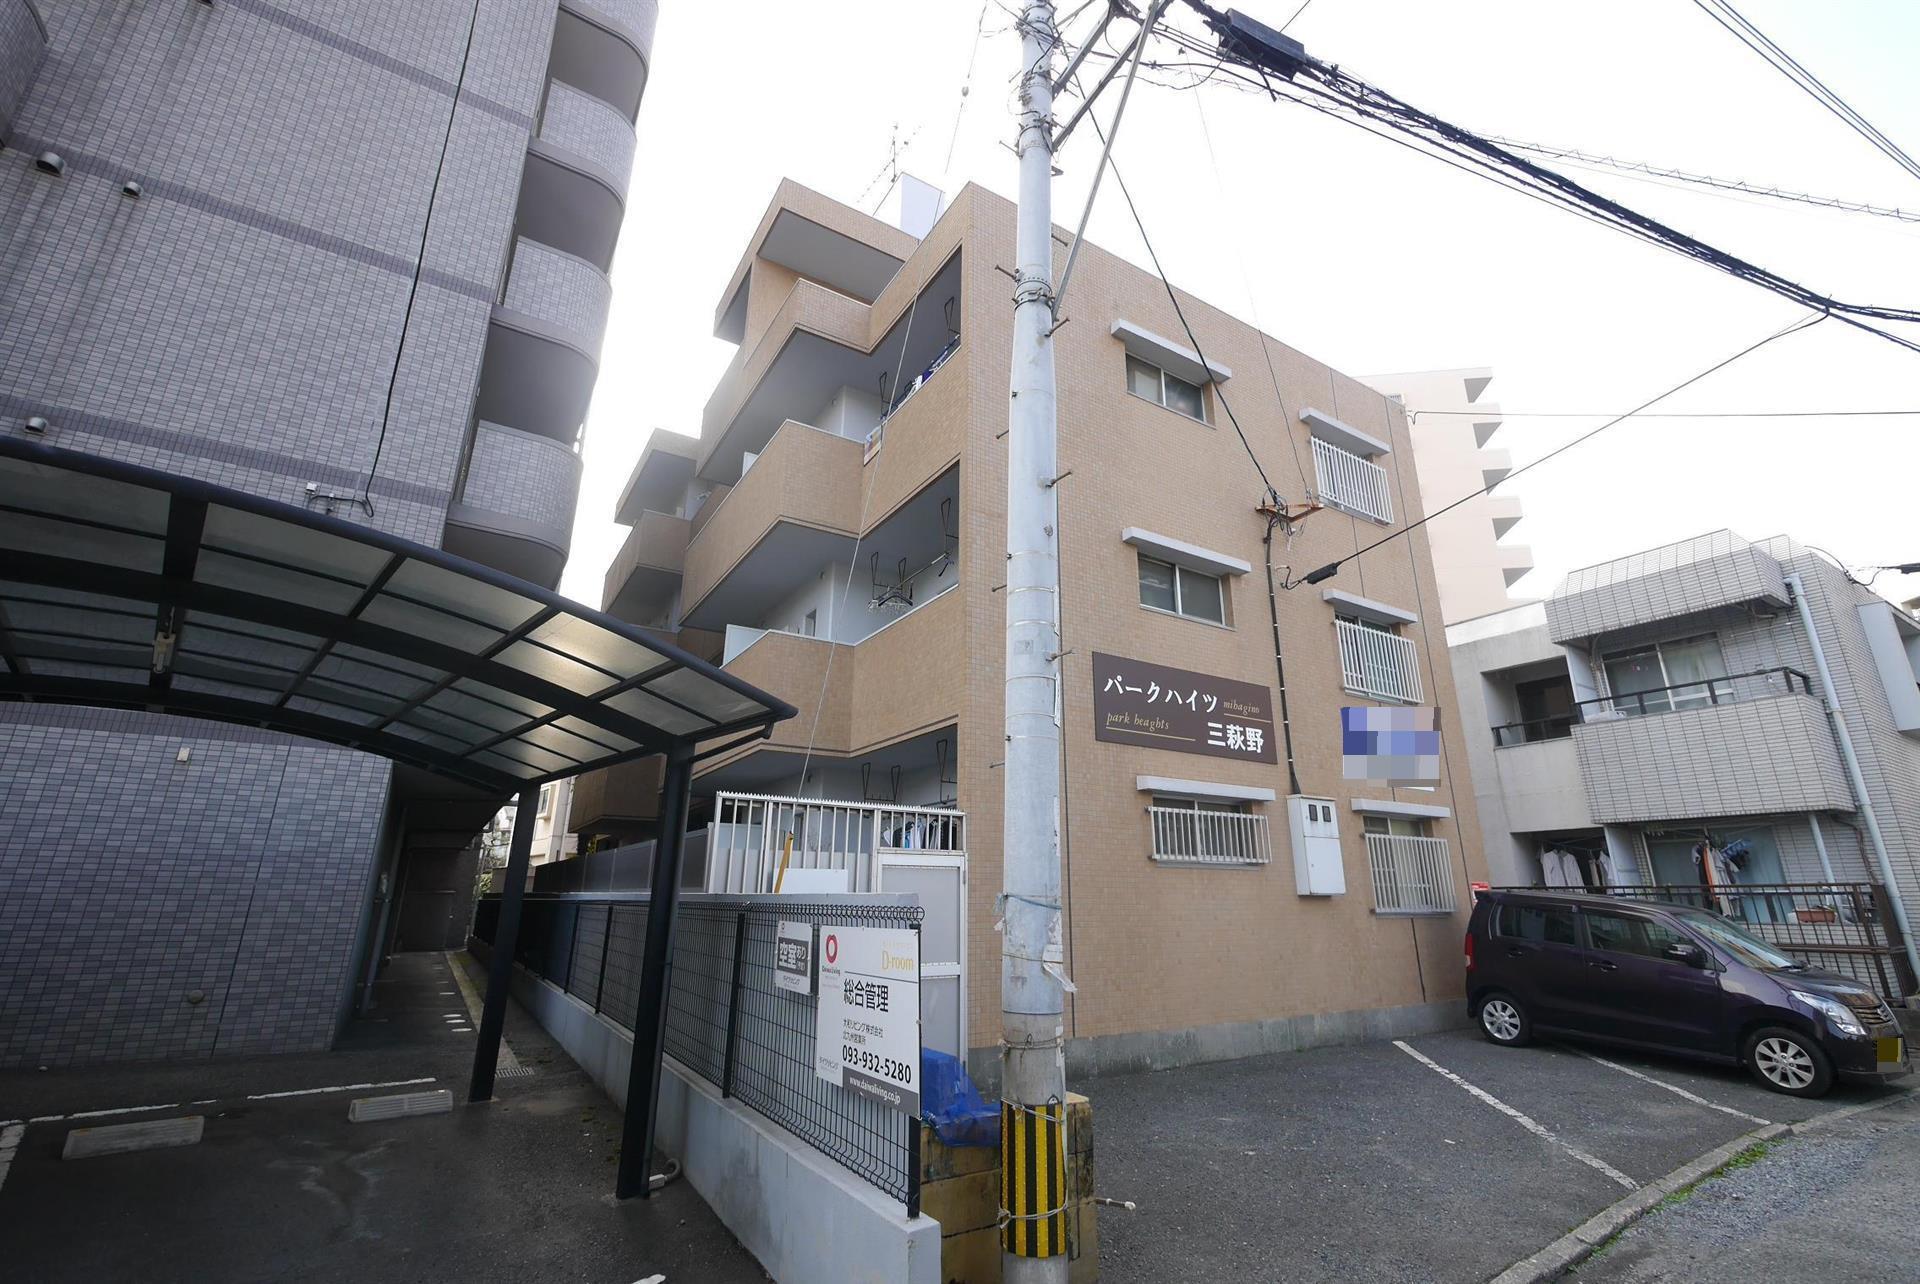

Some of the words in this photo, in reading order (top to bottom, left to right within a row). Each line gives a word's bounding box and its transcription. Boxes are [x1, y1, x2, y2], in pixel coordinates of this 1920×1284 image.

[1103, 674, 1218, 713] パークハイツ
[1106, 711, 1130, 726] park
[1207, 721, 1265, 753] 三萩野
[881, 950, 913, 971] D-room
[843, 978, 889, 1013] 総合管理
[842, 1044, 912, 1084] 093-932-5280
